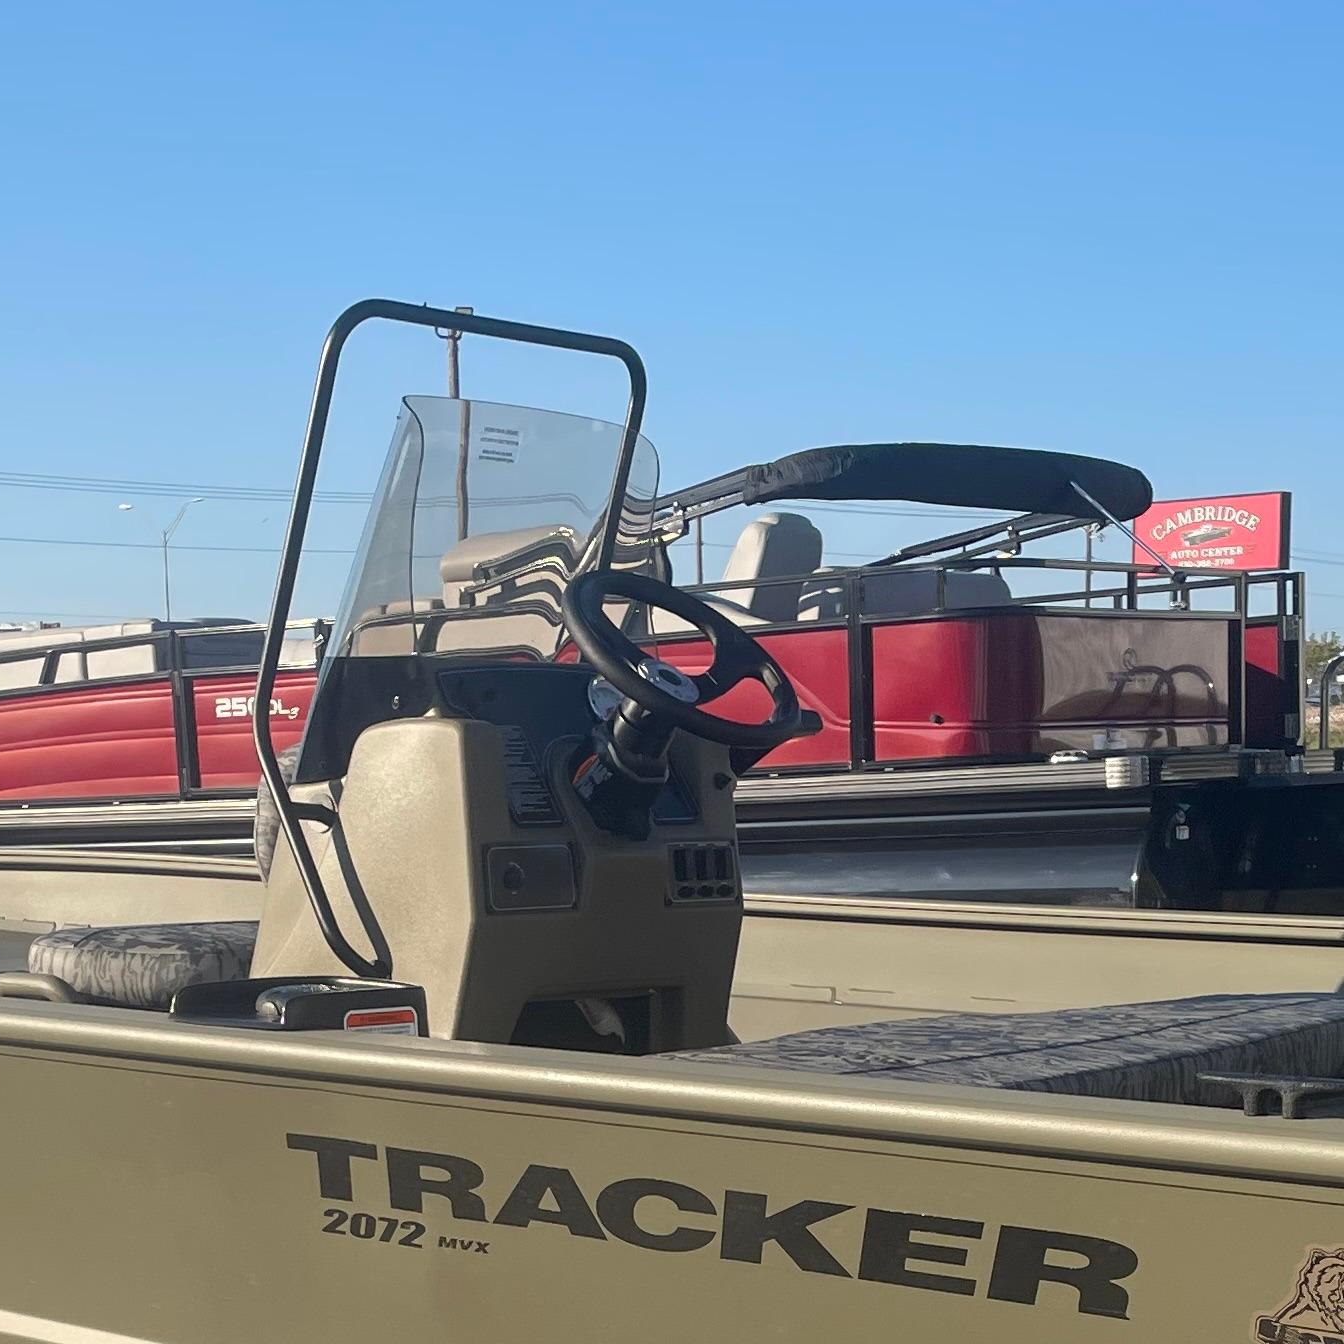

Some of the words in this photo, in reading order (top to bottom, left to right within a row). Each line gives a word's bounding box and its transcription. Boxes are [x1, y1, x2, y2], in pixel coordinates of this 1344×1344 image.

[1152, 506, 1260, 540] CAMBRIDGE
[1170, 549, 1199, 560] AUTO
[1200, 546, 1244, 558] CENTER
[286, 1133, 1139, 1320] TRACKER
[322, 1209, 427, 1249] 2072
[438, 1235, 491, 1255] MVX
